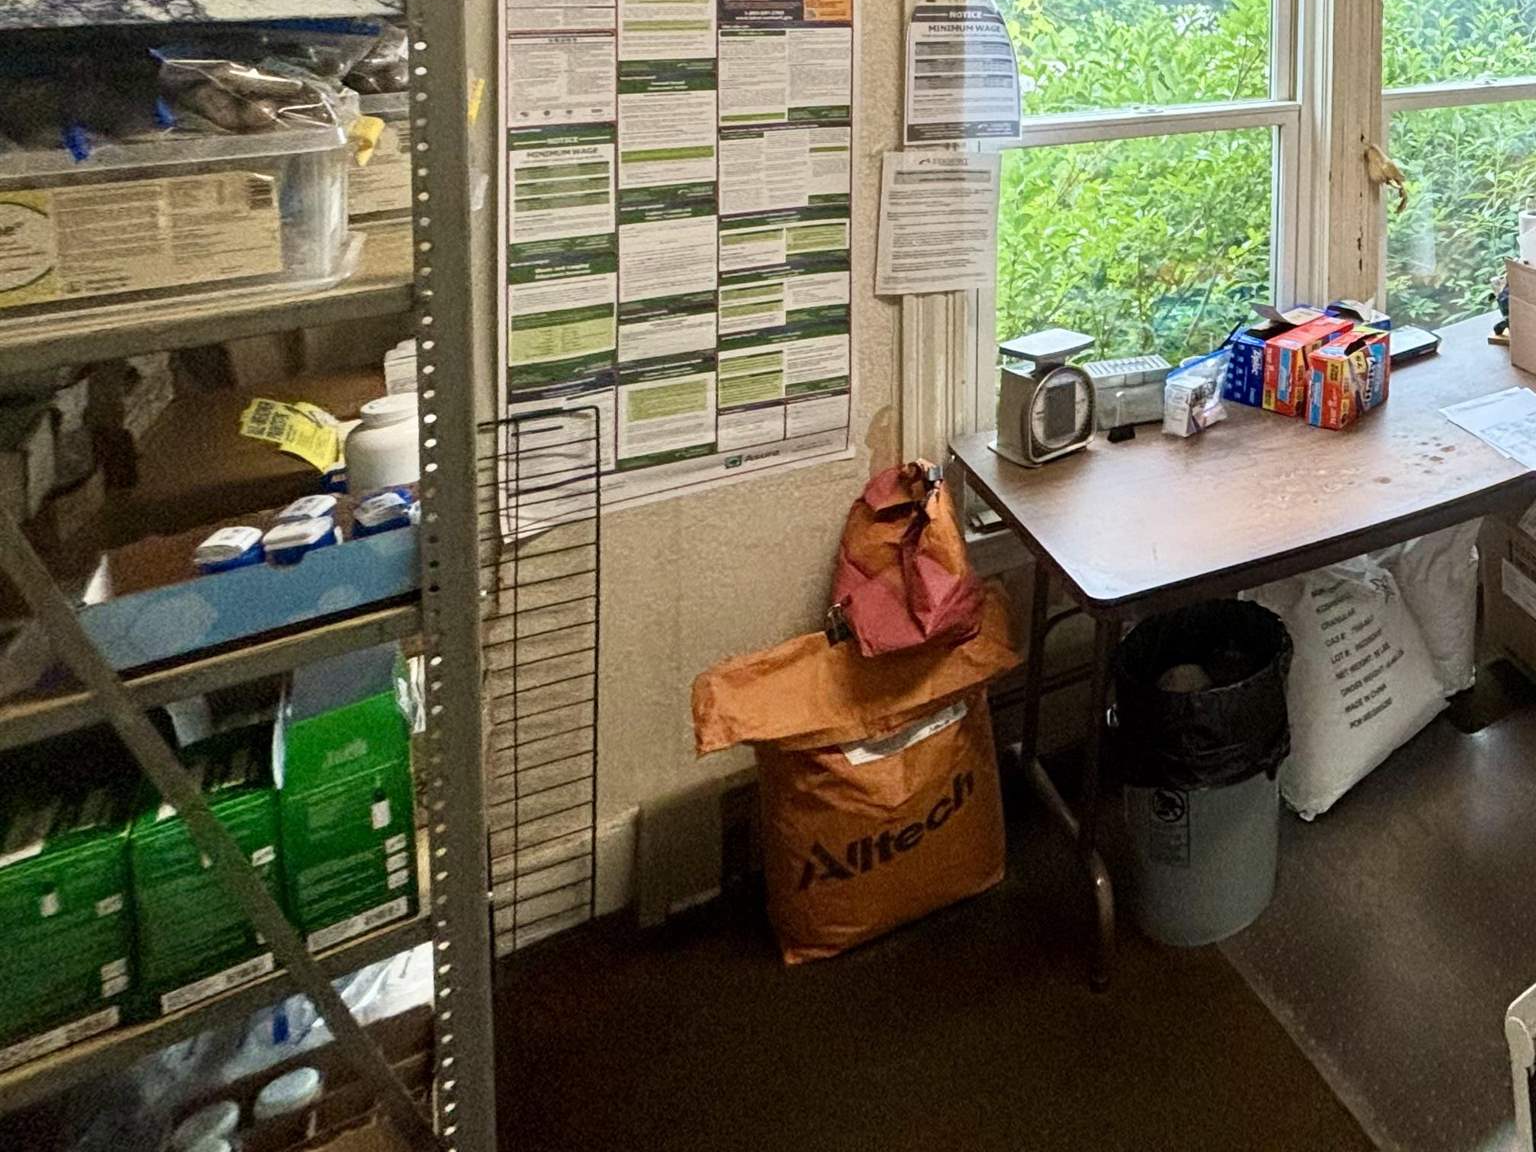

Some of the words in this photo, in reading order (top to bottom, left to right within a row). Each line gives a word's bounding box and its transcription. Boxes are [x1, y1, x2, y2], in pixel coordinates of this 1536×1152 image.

[948, 10, 982, 19] NOTICE
[928, 24, 973, 33] MINIMUM
[975, 24, 1000, 33] WAGE
[1345, 698, 1364, 713] MADE
[1371, 683, 1388, 698] CHINA
[800, 771, 975, 890] Alltech
